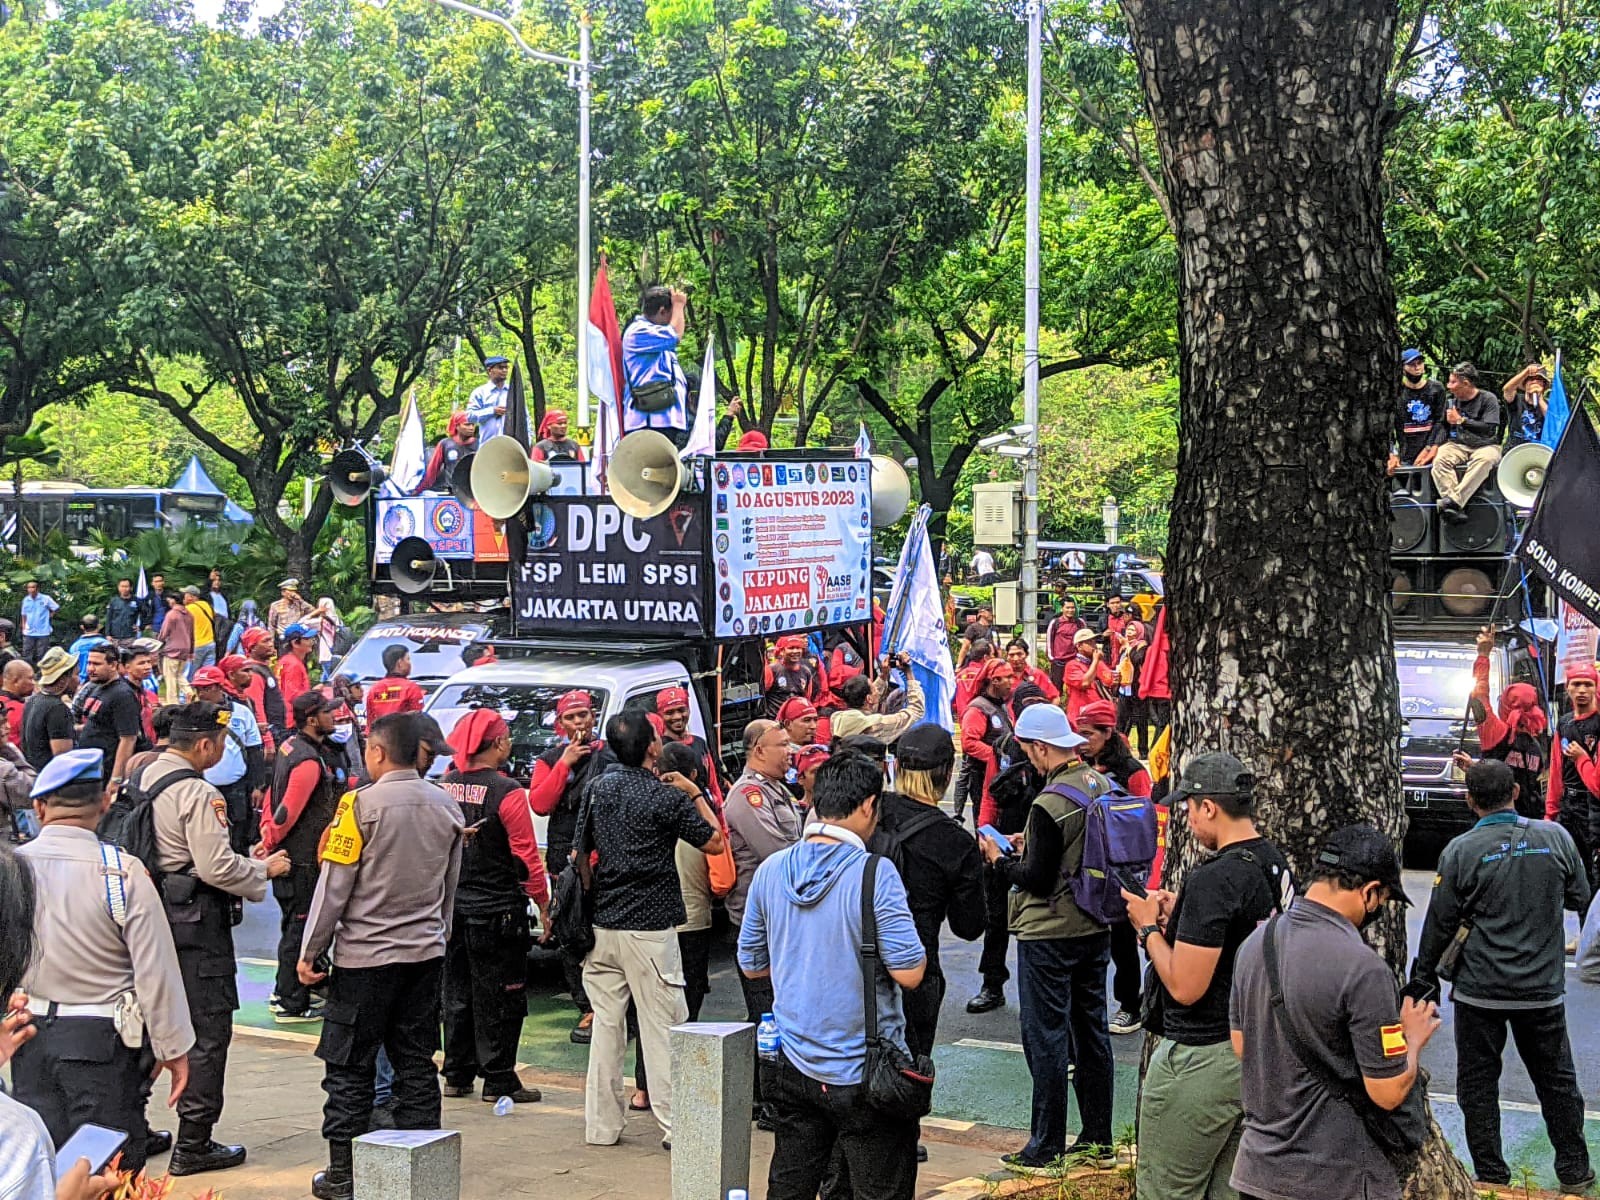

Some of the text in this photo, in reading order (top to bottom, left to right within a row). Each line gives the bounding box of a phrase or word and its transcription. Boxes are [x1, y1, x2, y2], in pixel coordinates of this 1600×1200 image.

[735, 489, 855, 508] 10 AGUSTUS 2023
[567, 503, 652, 553] DPC
[1526, 539, 1557, 580] SOLID,
[521, 562, 697, 586] FSP LEM SPSI
[744, 568, 809, 588] KEPUNG
[827, 574, 852, 587] AASB
[521, 597, 699, 623] JAKARTA UTARA
[746, 591, 809, 612] JAKARTA
[404, 627, 478, 641] KOMANDO
[465, 784, 488, 804] LEM
